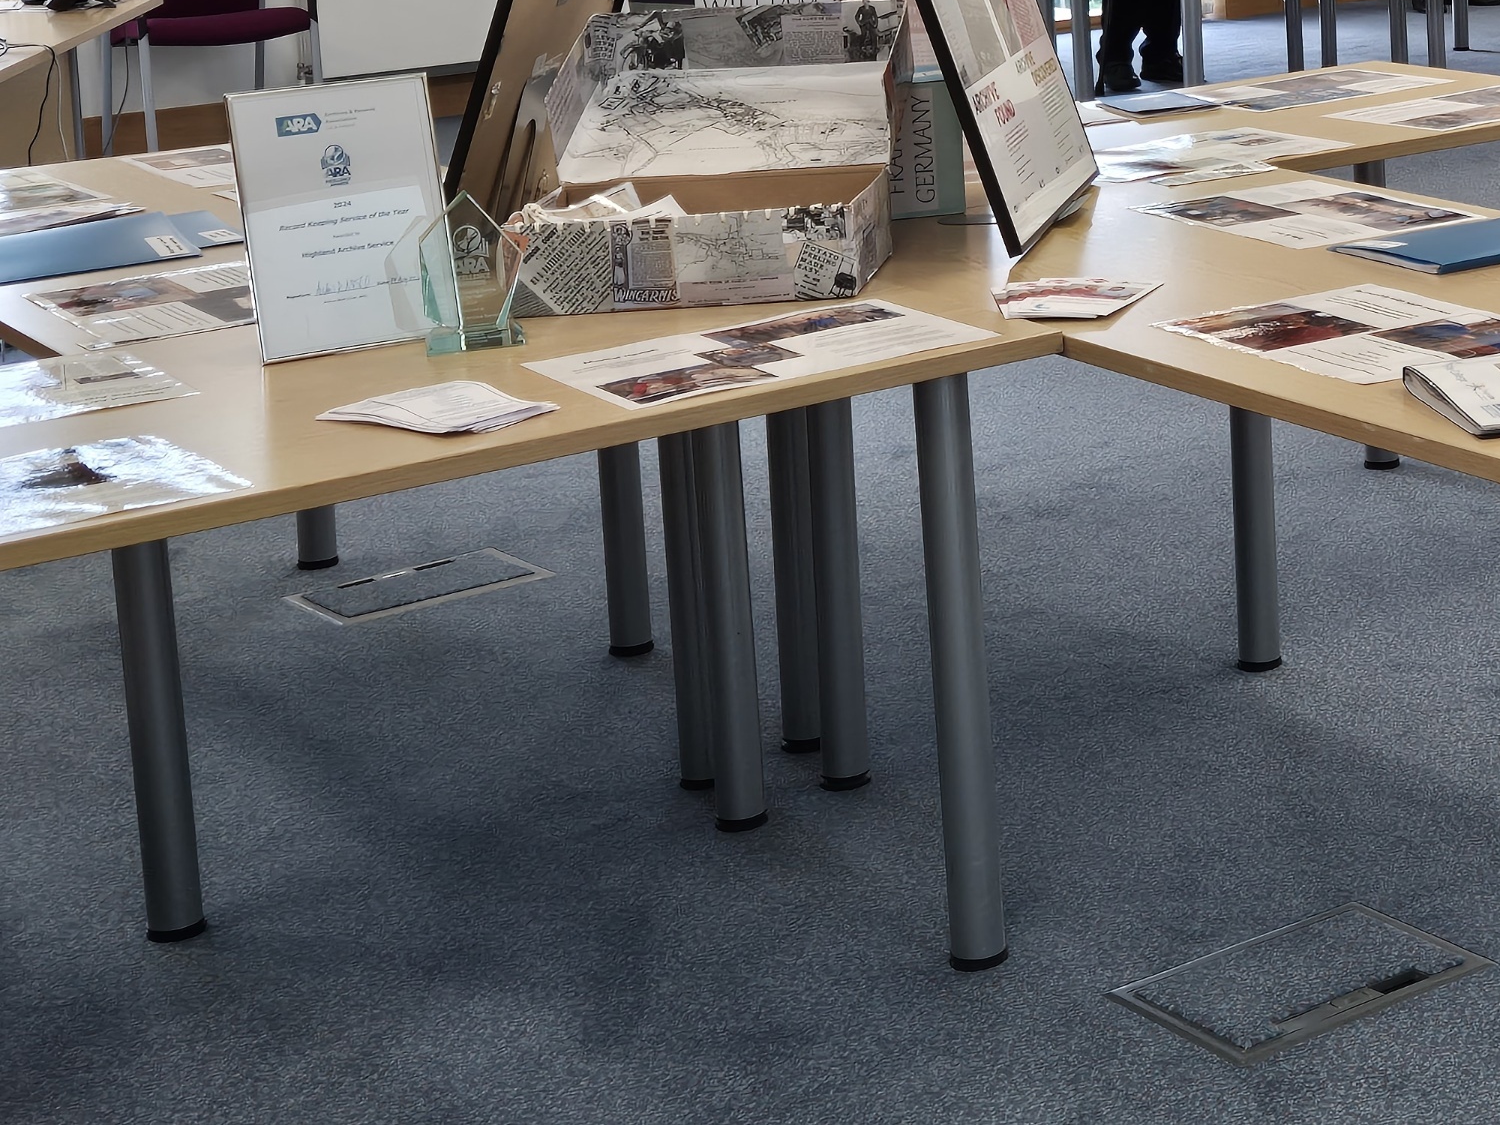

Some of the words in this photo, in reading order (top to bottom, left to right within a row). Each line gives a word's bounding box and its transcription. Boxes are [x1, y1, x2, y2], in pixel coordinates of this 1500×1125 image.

[971, 81, 1000, 116] ARCHIVE
[993, 98, 1017, 128] FOUND
[282, 114, 318, 133] ARA
[911, 95, 936, 203] GERMANY
[326, 165, 352, 178] ARA
[333, 200, 352, 209] 2024
[278, 222, 307, 232] Record
[307, 219, 338, 229] Keeping
[339, 214, 368, 224] Service
[368, 211, 378, 219] of
[301, 248, 336, 259] Highland
[337, 244, 366, 254] Archive
[366, 240, 395, 250] Service
[802, 250, 837, 267] PEELING
[804, 244, 840, 261] POTATO
[799, 256, 825, 271] MADE
